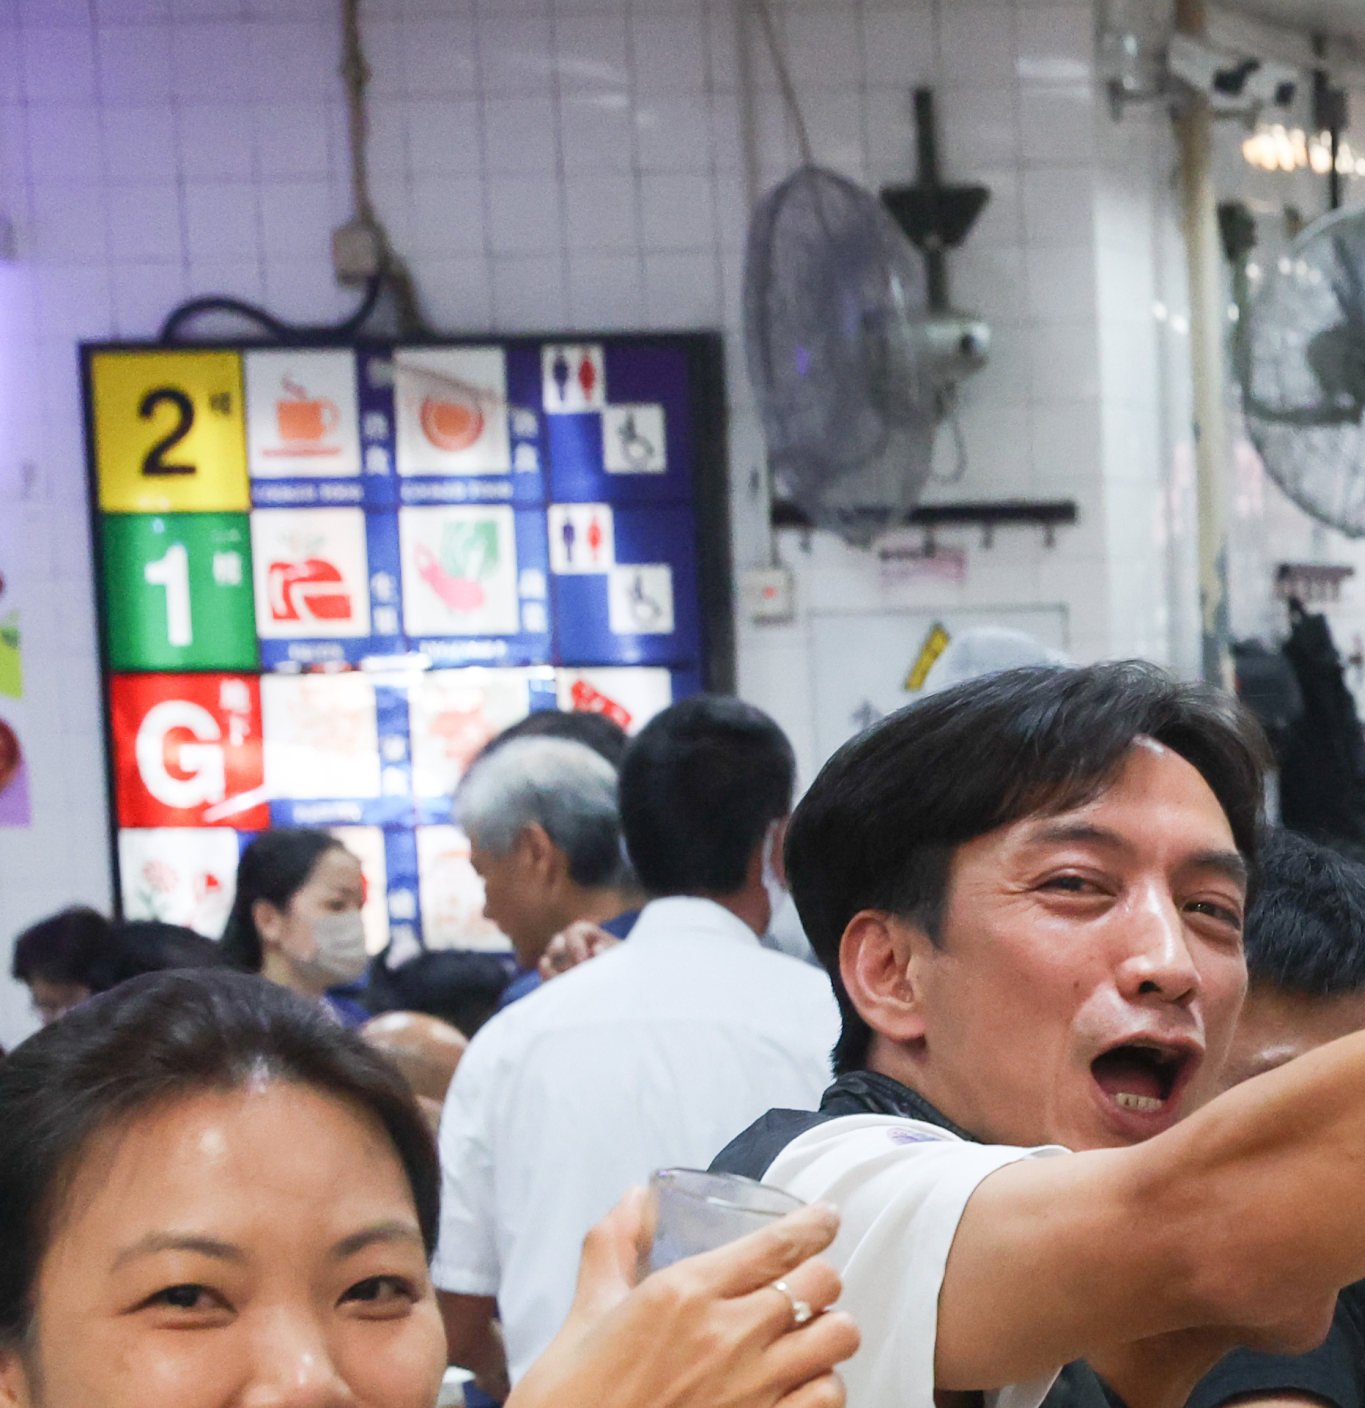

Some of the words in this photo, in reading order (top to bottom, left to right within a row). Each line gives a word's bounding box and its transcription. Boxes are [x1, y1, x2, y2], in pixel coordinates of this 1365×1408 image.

[138, 386, 196, 477] 2
[144, 544, 193, 648] 1
[136, 699, 226, 808] G
